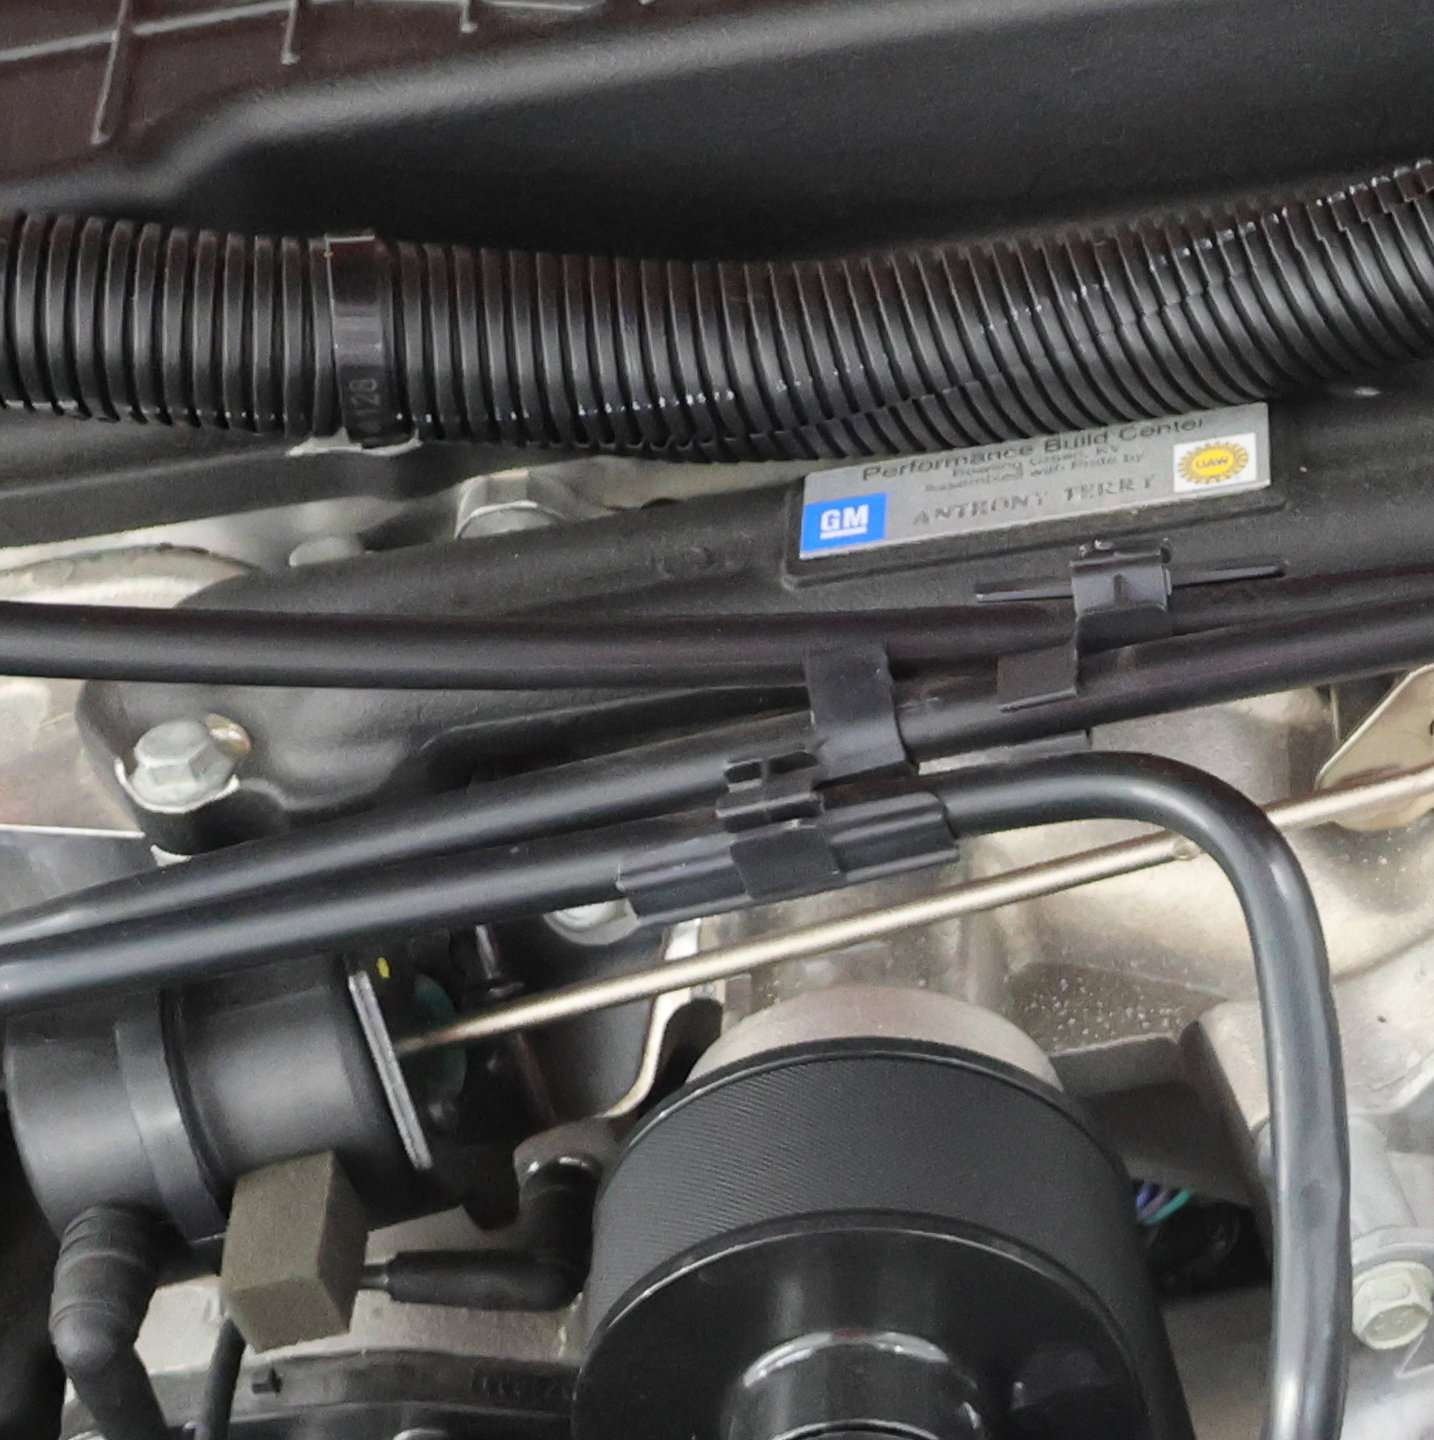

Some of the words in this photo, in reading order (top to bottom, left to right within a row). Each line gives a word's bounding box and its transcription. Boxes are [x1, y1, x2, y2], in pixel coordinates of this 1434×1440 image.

[863, 444, 1034, 480] Performance
[1044, 429, 1109, 453] Build
[1119, 417, 1203, 441] Center
[1196, 455, 1229, 469] UAW
[820, 504, 869, 534] GM
